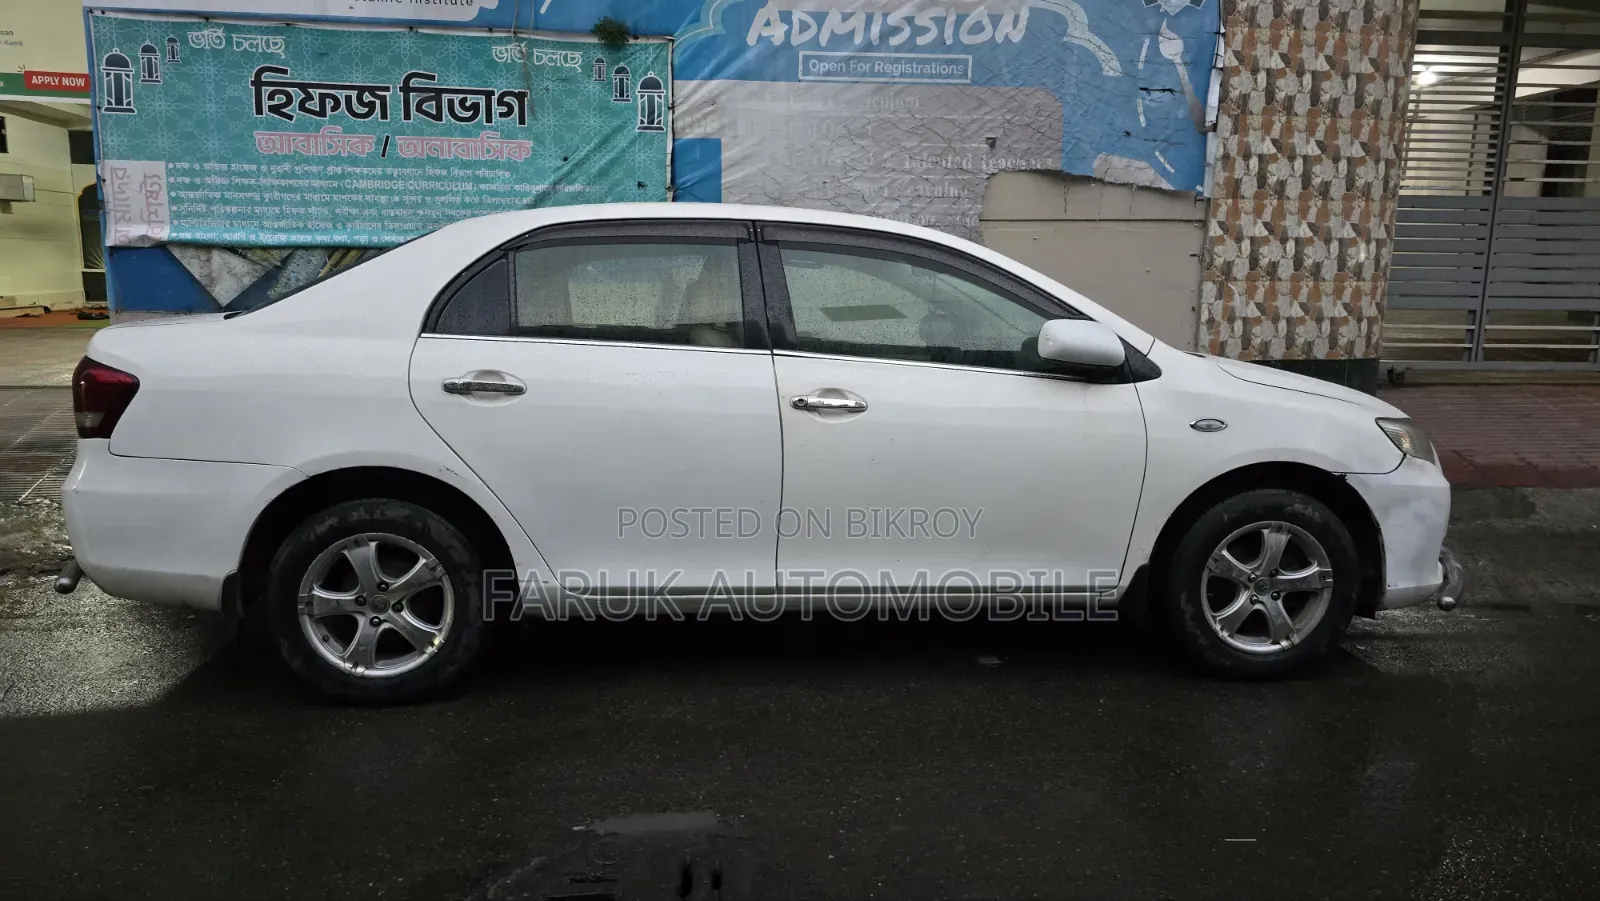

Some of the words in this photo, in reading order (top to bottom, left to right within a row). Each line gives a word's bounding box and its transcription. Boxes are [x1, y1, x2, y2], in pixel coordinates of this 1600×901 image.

[746, 0, 1030, 47] ADMISSION
[187, 27, 226, 49] ভর্তি
[231, 34, 286, 59] চলছে
[533, 48, 583, 73] চলছে
[808, 59, 846, 73] Open
[850, 60, 872, 72] For
[875, 61, 964, 76] Registrations
[32, 75, 60, 86] APPLY
[62, 77, 86, 87] NOW
[250, 65, 392, 123] হিফজ
[398, 71, 530, 127] বিভাগ
[254, 126, 376, 158] আবাসিক
[396, 131, 533, 161] অনাবাসিক
[451, 167, 473, 178] বিভাগ
[981, 154, 1054, 170] Teachers
